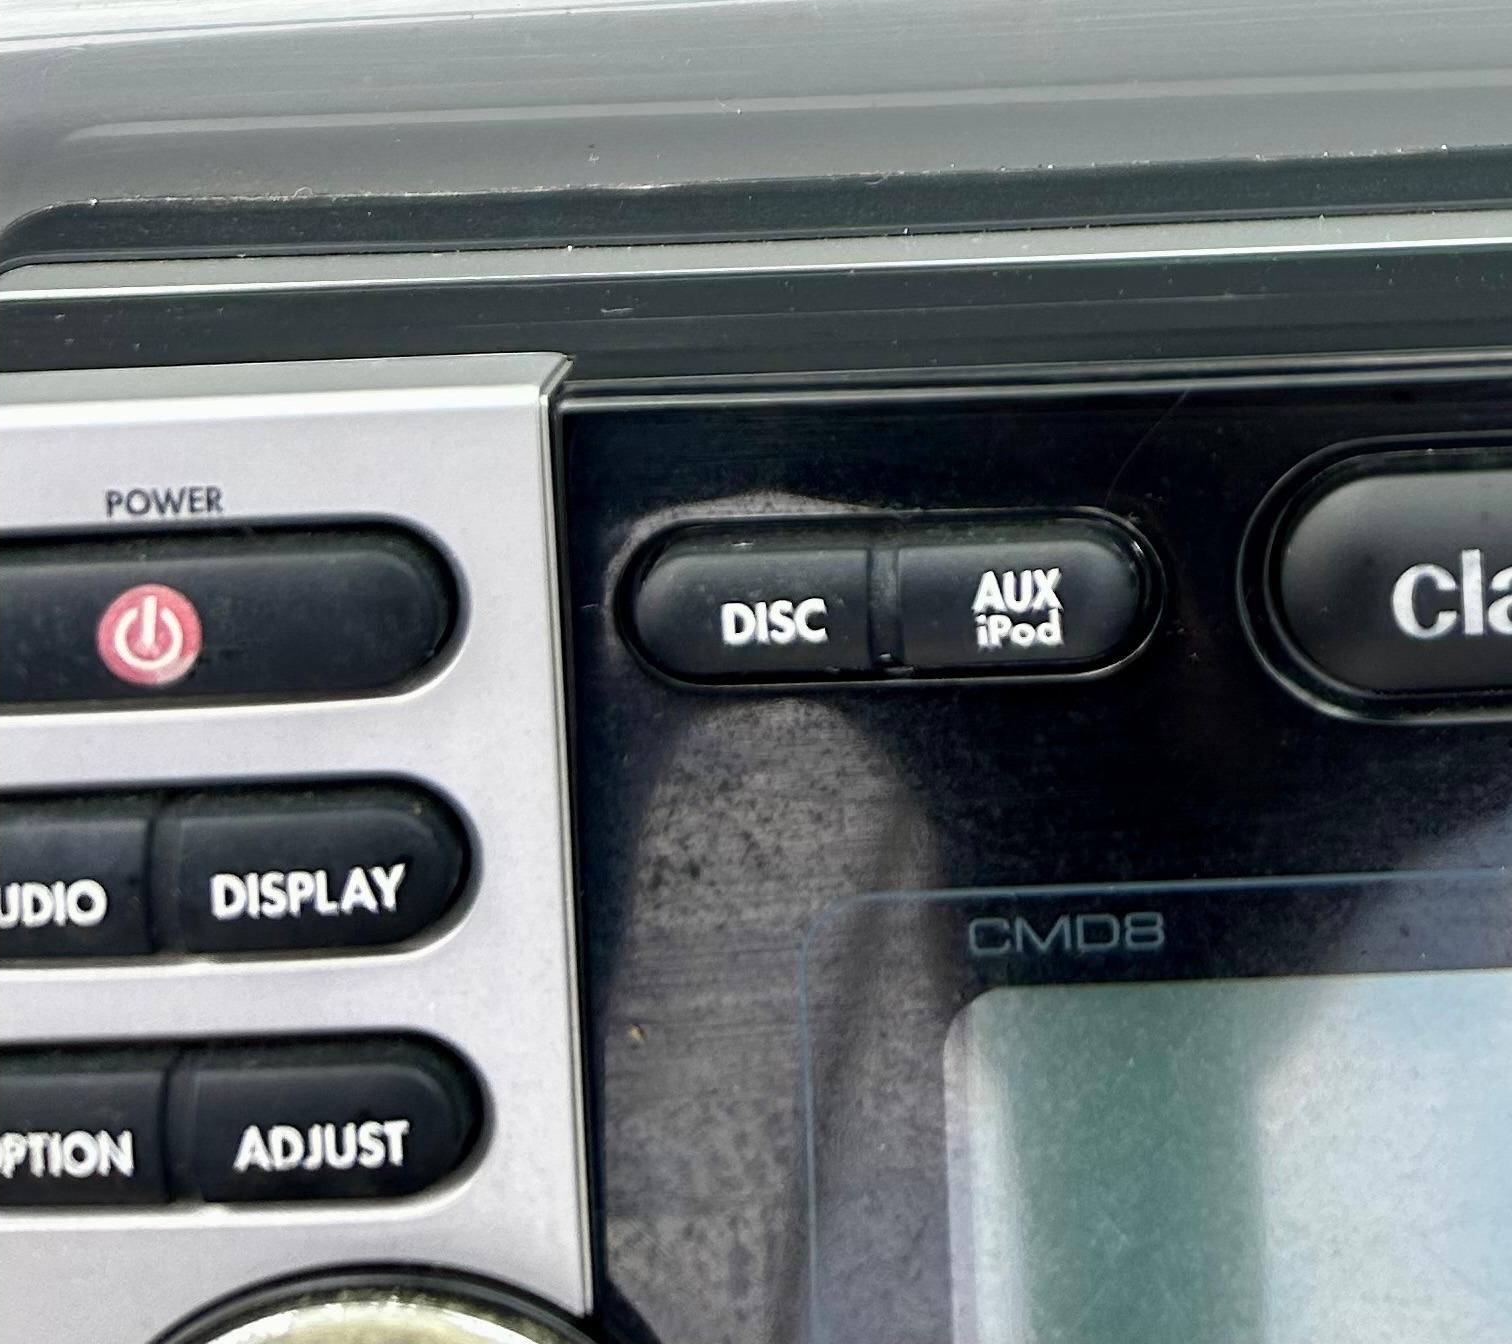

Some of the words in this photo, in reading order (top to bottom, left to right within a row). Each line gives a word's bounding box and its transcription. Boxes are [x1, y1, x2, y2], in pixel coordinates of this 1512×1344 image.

[106, 486, 224, 518] POWER
[973, 568, 1062, 612] AUX
[720, 598, 828, 646] DISC
[975, 609, 1063, 648] iPod
[210, 864, 406, 921] DISPLAY
[968, 911, 1165, 955] CMD8
[234, 1120, 410, 1172] ADJUST
